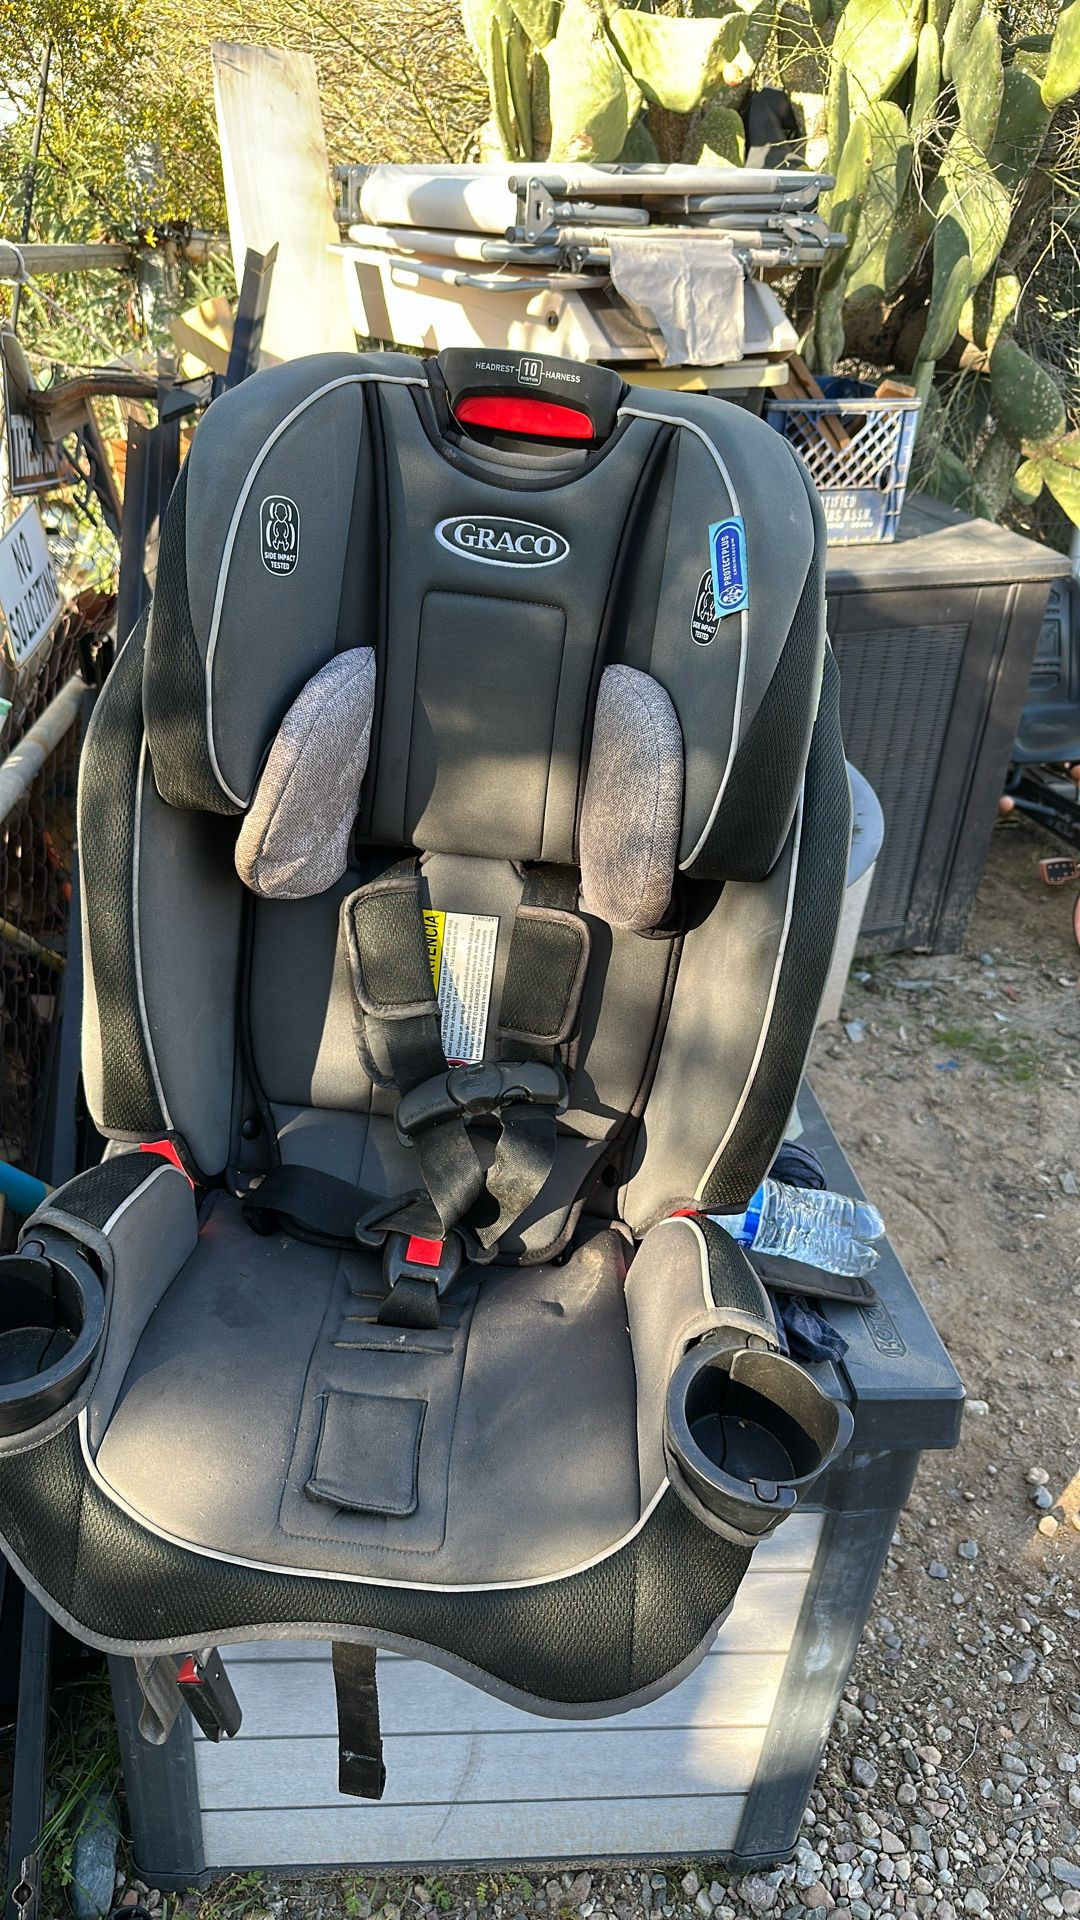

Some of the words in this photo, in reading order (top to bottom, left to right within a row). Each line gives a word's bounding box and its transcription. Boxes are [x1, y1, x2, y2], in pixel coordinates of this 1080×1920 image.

[476, 361, 515, 374] HEADREST
[523, 361, 538, 377] 10
[545, 371, 581, 383] HARNESS
[520, 375, 539, 383] POSITION
[454, 523, 557, 557] GRACO
[11, 531, 33, 585] NO
[264, 551, 277, 560] SIDE
[277, 553, 296, 562] IMPACT
[270, 561, 290, 570] TESTED
[721, 535, 732, 586] PROTECTPLUS
[9, 561, 59, 655] SOLICITING
